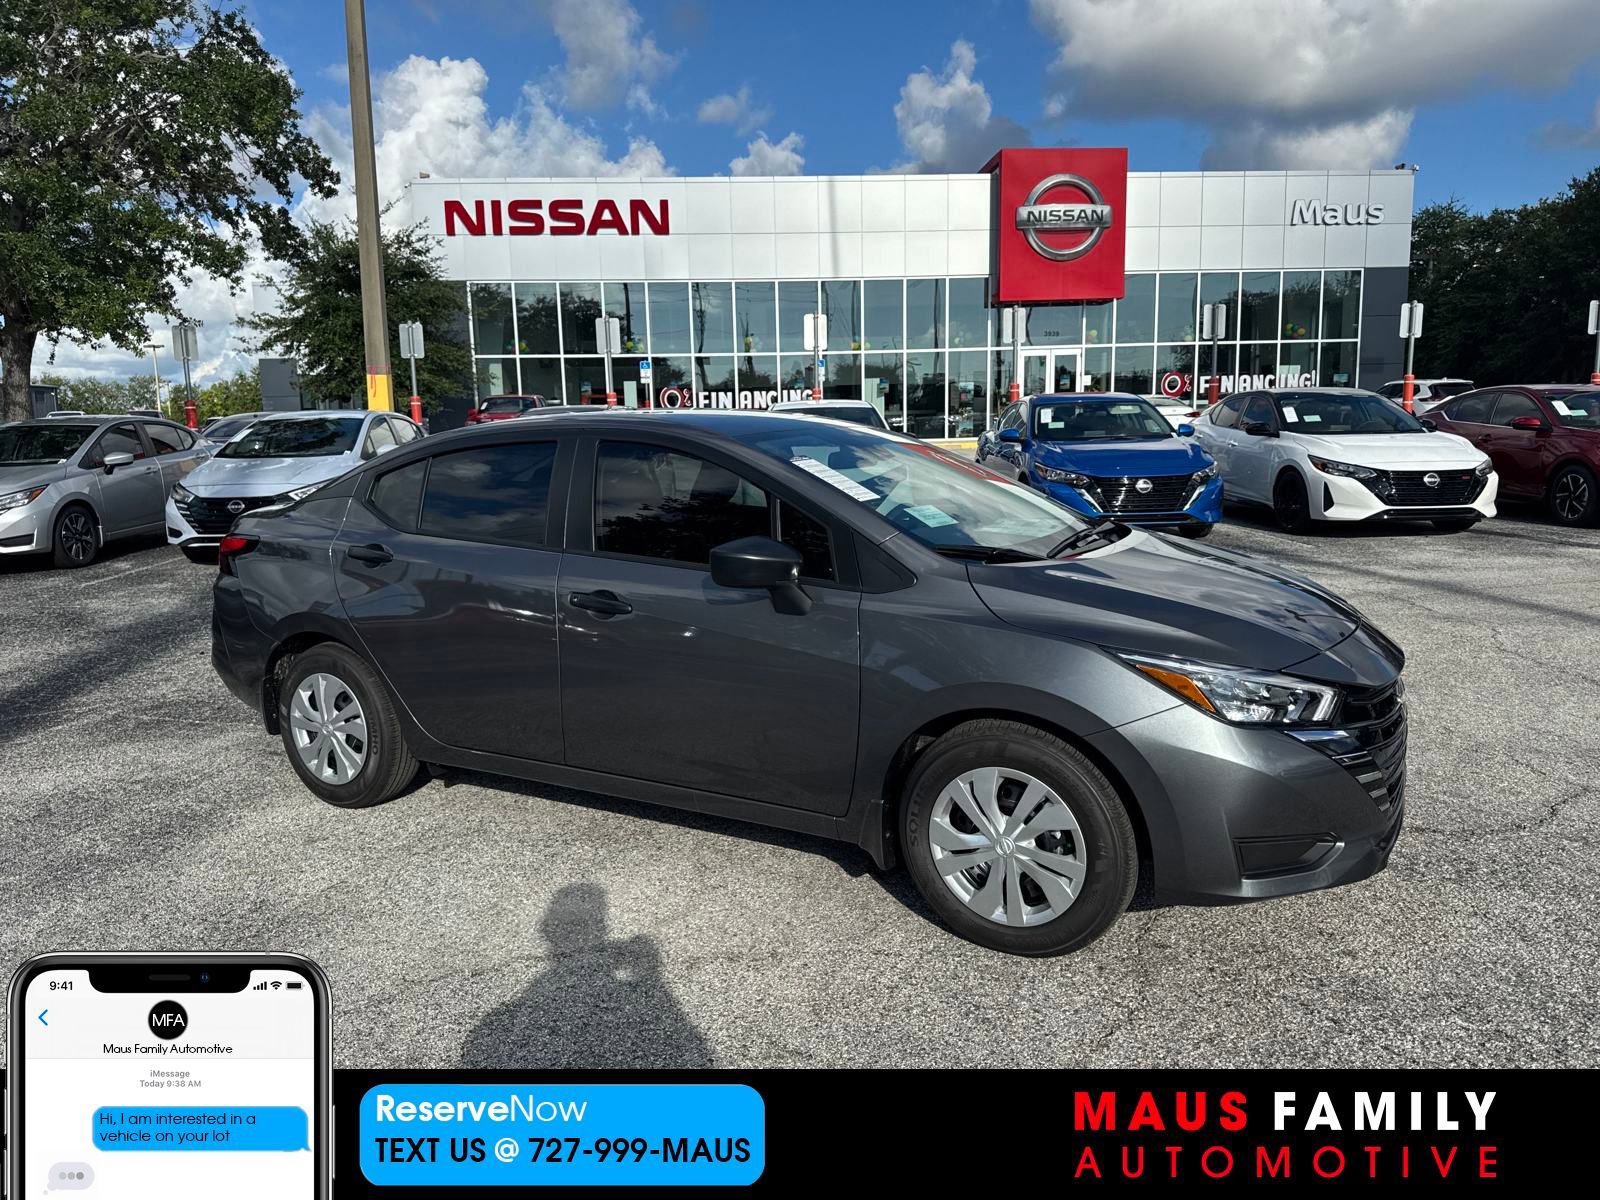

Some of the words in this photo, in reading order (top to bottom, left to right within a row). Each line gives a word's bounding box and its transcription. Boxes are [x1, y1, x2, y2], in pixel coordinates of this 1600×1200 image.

[444, 199, 670, 237] NISSAN
[1026, 208, 1104, 223] NISSAN
[1290, 199, 1385, 226] Maus
